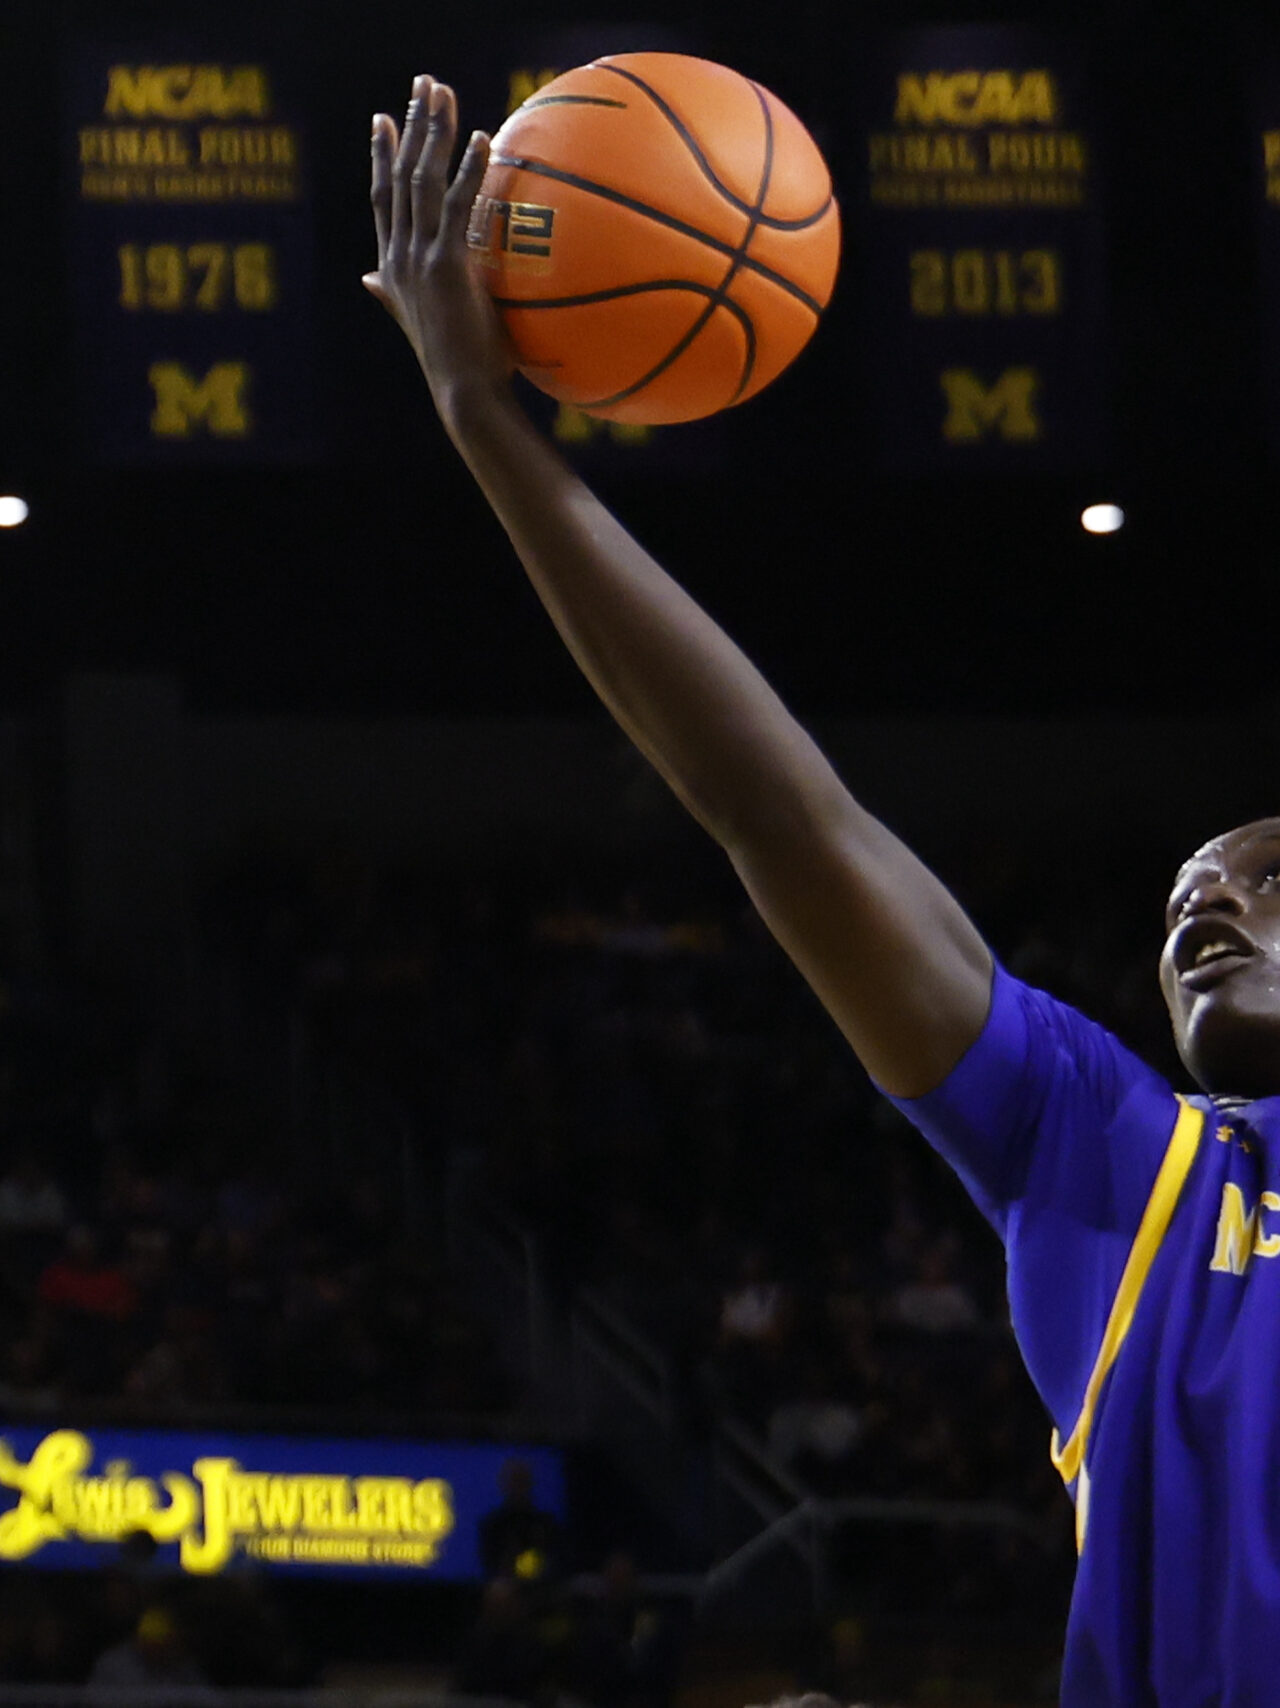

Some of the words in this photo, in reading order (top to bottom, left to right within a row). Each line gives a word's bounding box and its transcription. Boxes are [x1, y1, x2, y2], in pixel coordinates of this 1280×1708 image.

[105, 66, 269, 118] NCAA
[894, 70, 1057, 124] NCAA
[78, 126, 190, 166] FINAL
[199, 126, 296, 166] FOUR
[868, 134, 978, 172] FINAL
[987, 134, 1086, 172] FOUR
[117, 244, 273, 310] 1976
[910, 250, 1063, 316] 2013
[149, 362, 251, 438] M
[940, 367, 1041, 441] M
[181, 1456, 456, 1575] JEWELERS
